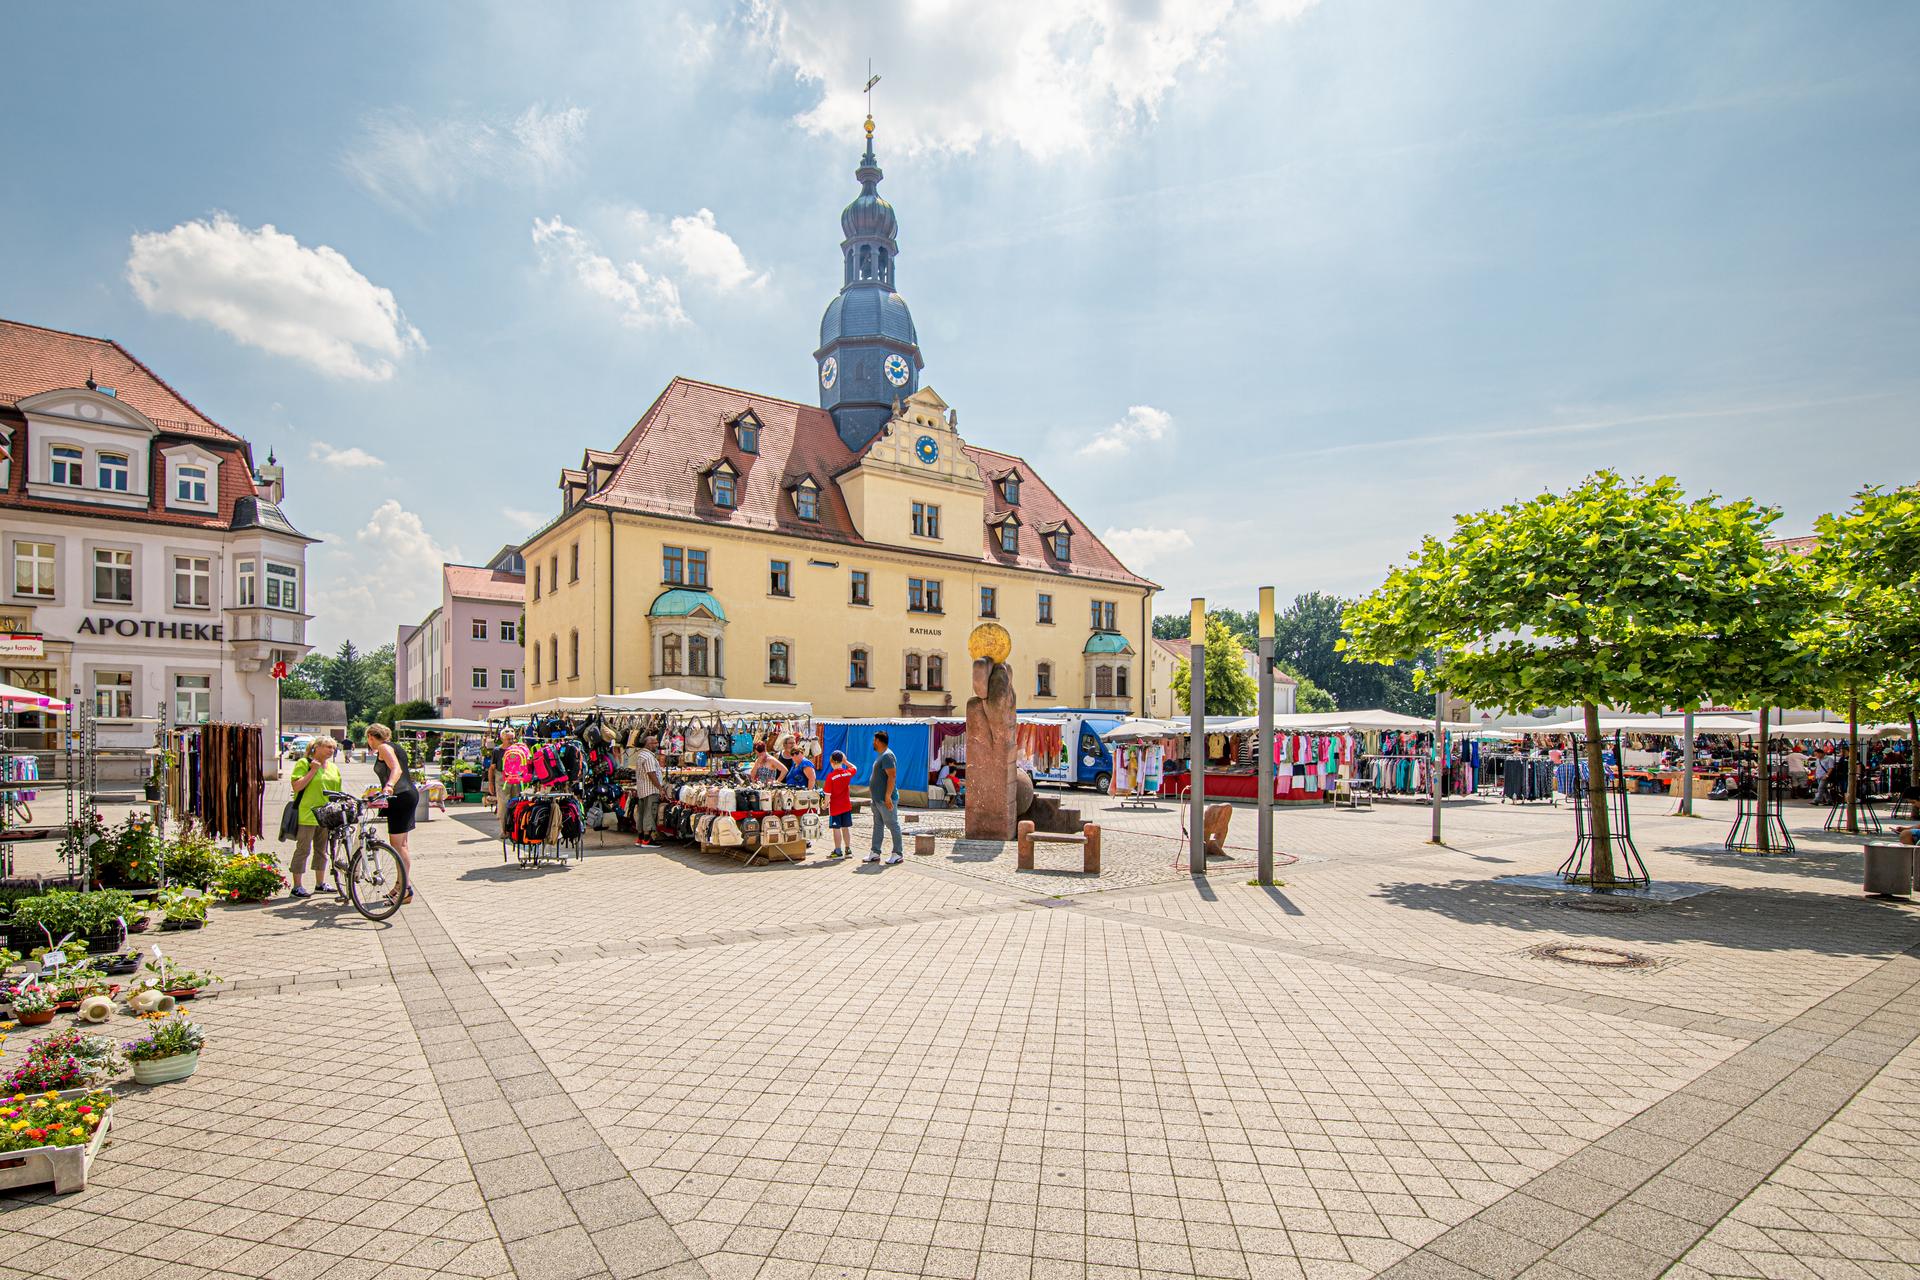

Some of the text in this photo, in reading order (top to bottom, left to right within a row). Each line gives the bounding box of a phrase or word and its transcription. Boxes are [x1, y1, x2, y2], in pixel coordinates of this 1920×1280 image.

[77, 616, 223, 641] APOTHEKE
[909, 627, 942, 636] RATHAUS
[15, 644, 37, 652] family
